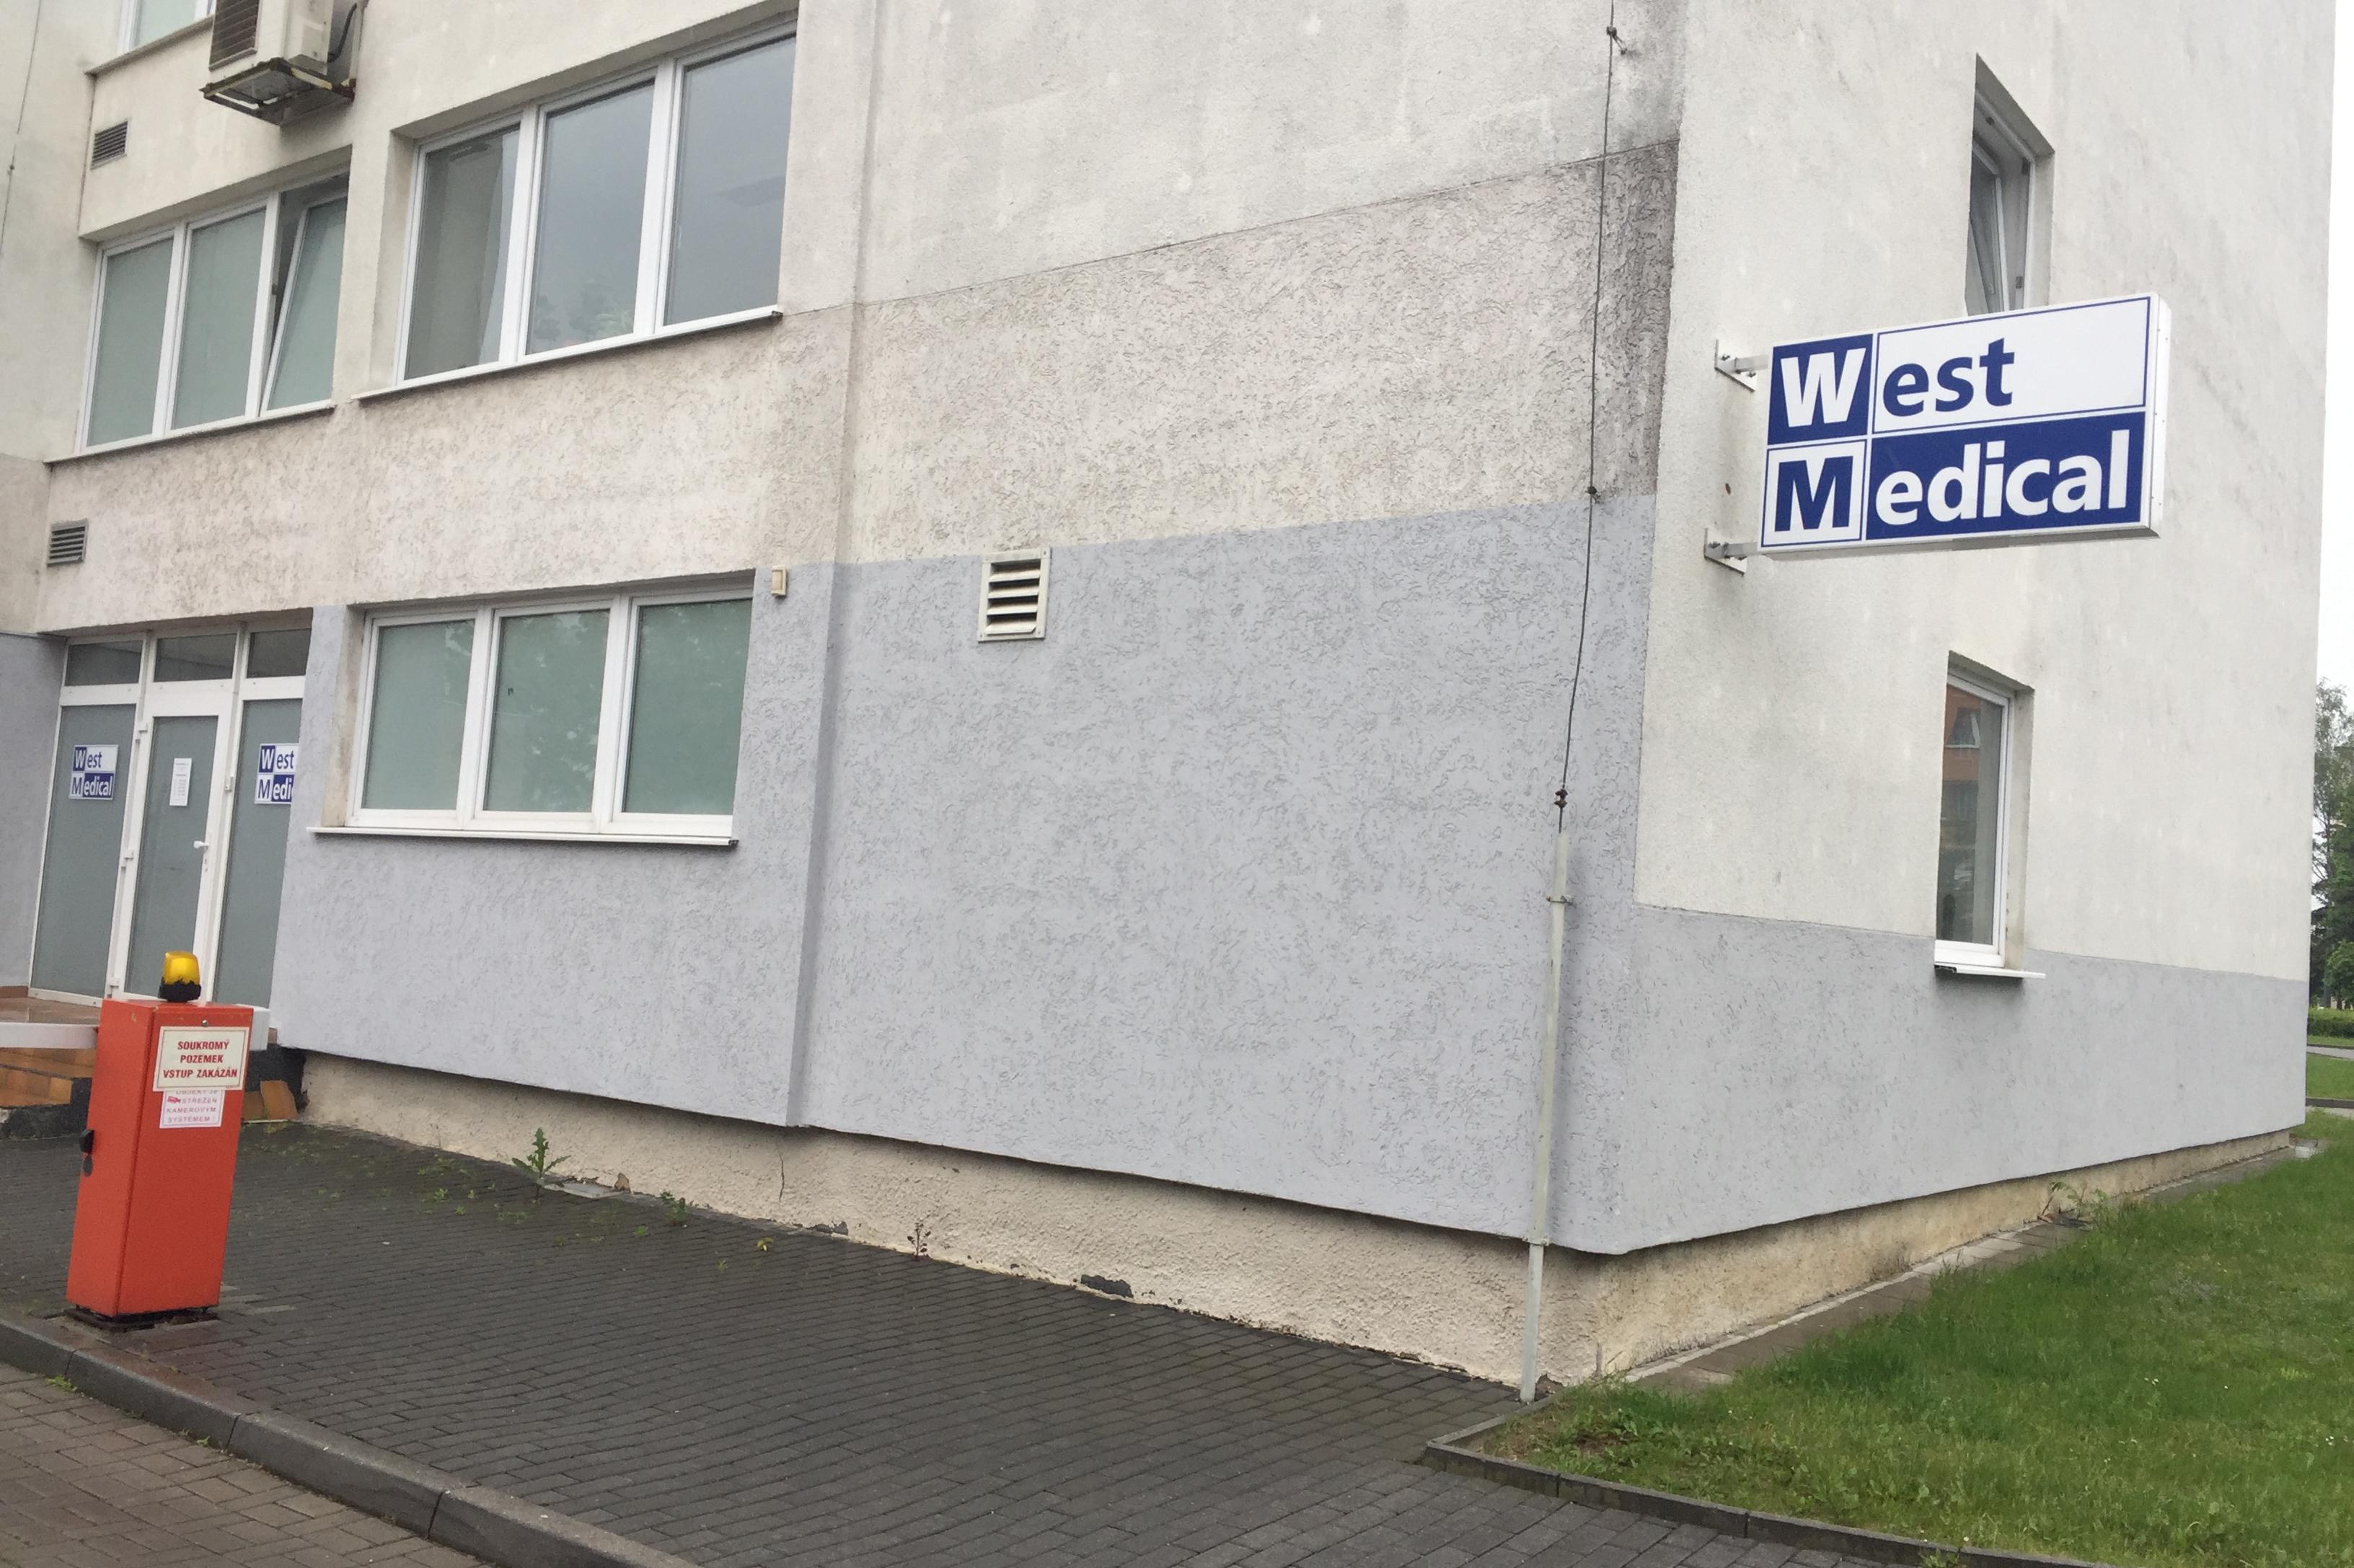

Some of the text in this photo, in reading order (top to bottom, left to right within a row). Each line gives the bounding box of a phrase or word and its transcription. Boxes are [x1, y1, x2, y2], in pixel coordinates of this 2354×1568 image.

[1780, 338, 2015, 428] West
[1774, 428, 2130, 532] Medical
[75, 749, 102, 768] West
[262, 749, 294, 770] West
[71, 775, 113, 796] Medical
[177, 1039, 229, 1050] SOUKROMÝ
[180, 1054, 224, 1063] POZEMEK
[163, 1070, 193, 1078] VSTUP
